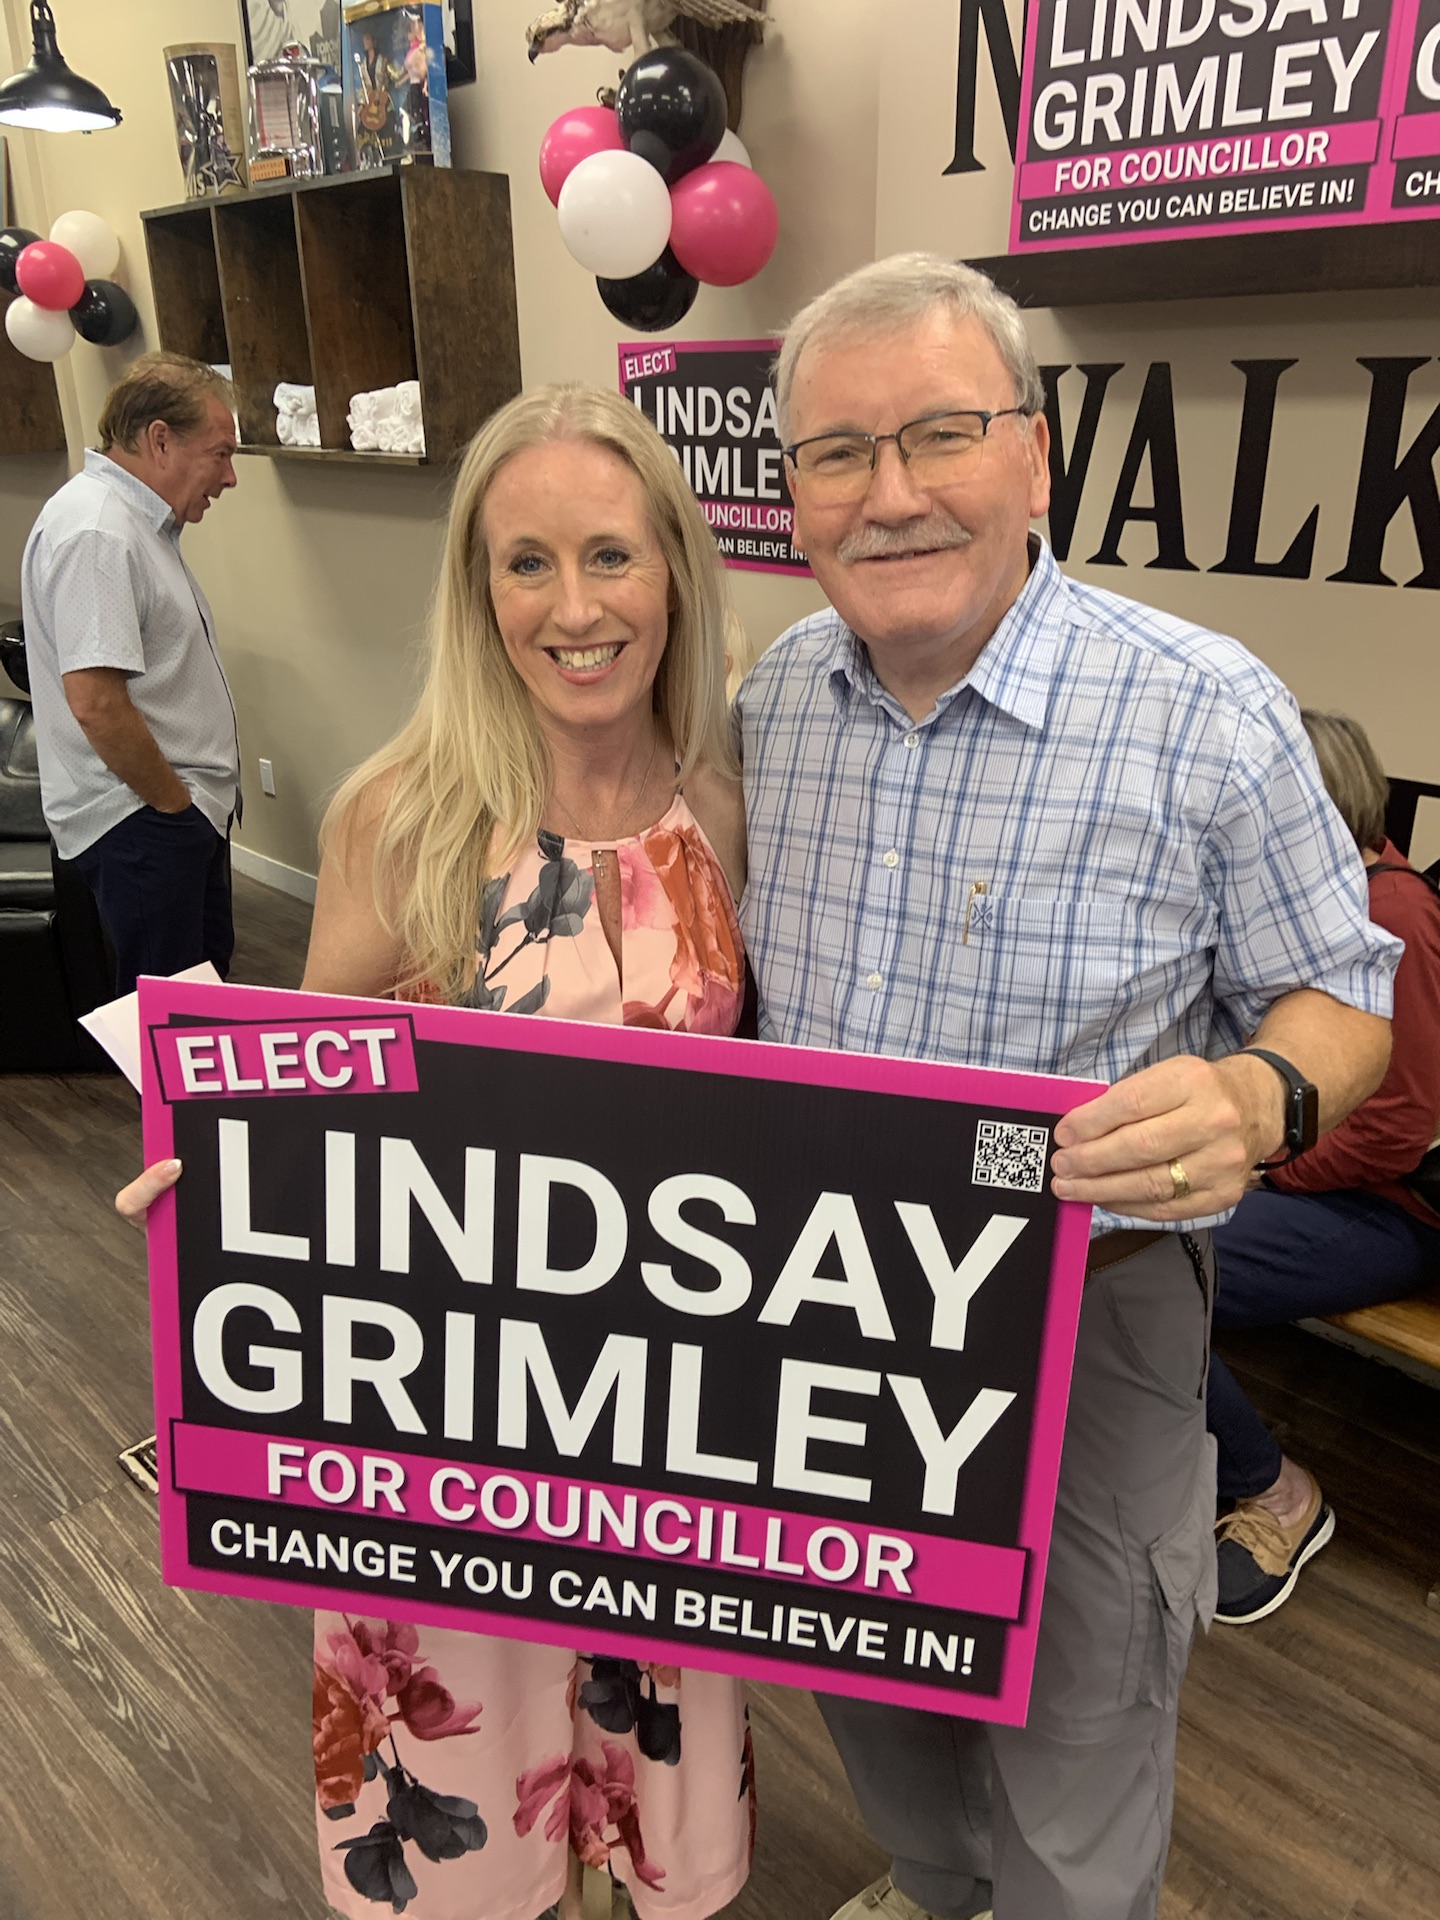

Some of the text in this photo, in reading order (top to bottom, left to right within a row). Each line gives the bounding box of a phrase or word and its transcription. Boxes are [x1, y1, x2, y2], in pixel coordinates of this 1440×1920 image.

[1051, 0, 1360, 68] LINDS
[1033, 30, 1381, 152] GRIMLEY
[1055, 131, 1330, 192] FOR COUNCILLOR
[1029, 178, 1354, 232] CHANGE YOU CAN BELIEVE IN!
[625, 349, 673, 380] ELECT
[716, 537, 735, 553] AN
[737, 539, 787, 559] BELIEVE
[176, 1028, 396, 1093] ELECT
[219, 1118, 1029, 1351] LINDSAY
[193, 1282, 1017, 1516] GRIMLEY
[267, 1442, 914, 1594] FOR COUNCILLOR
[210, 1519, 975, 1675] CHANGE YOU CAN BELIEVE IN!
